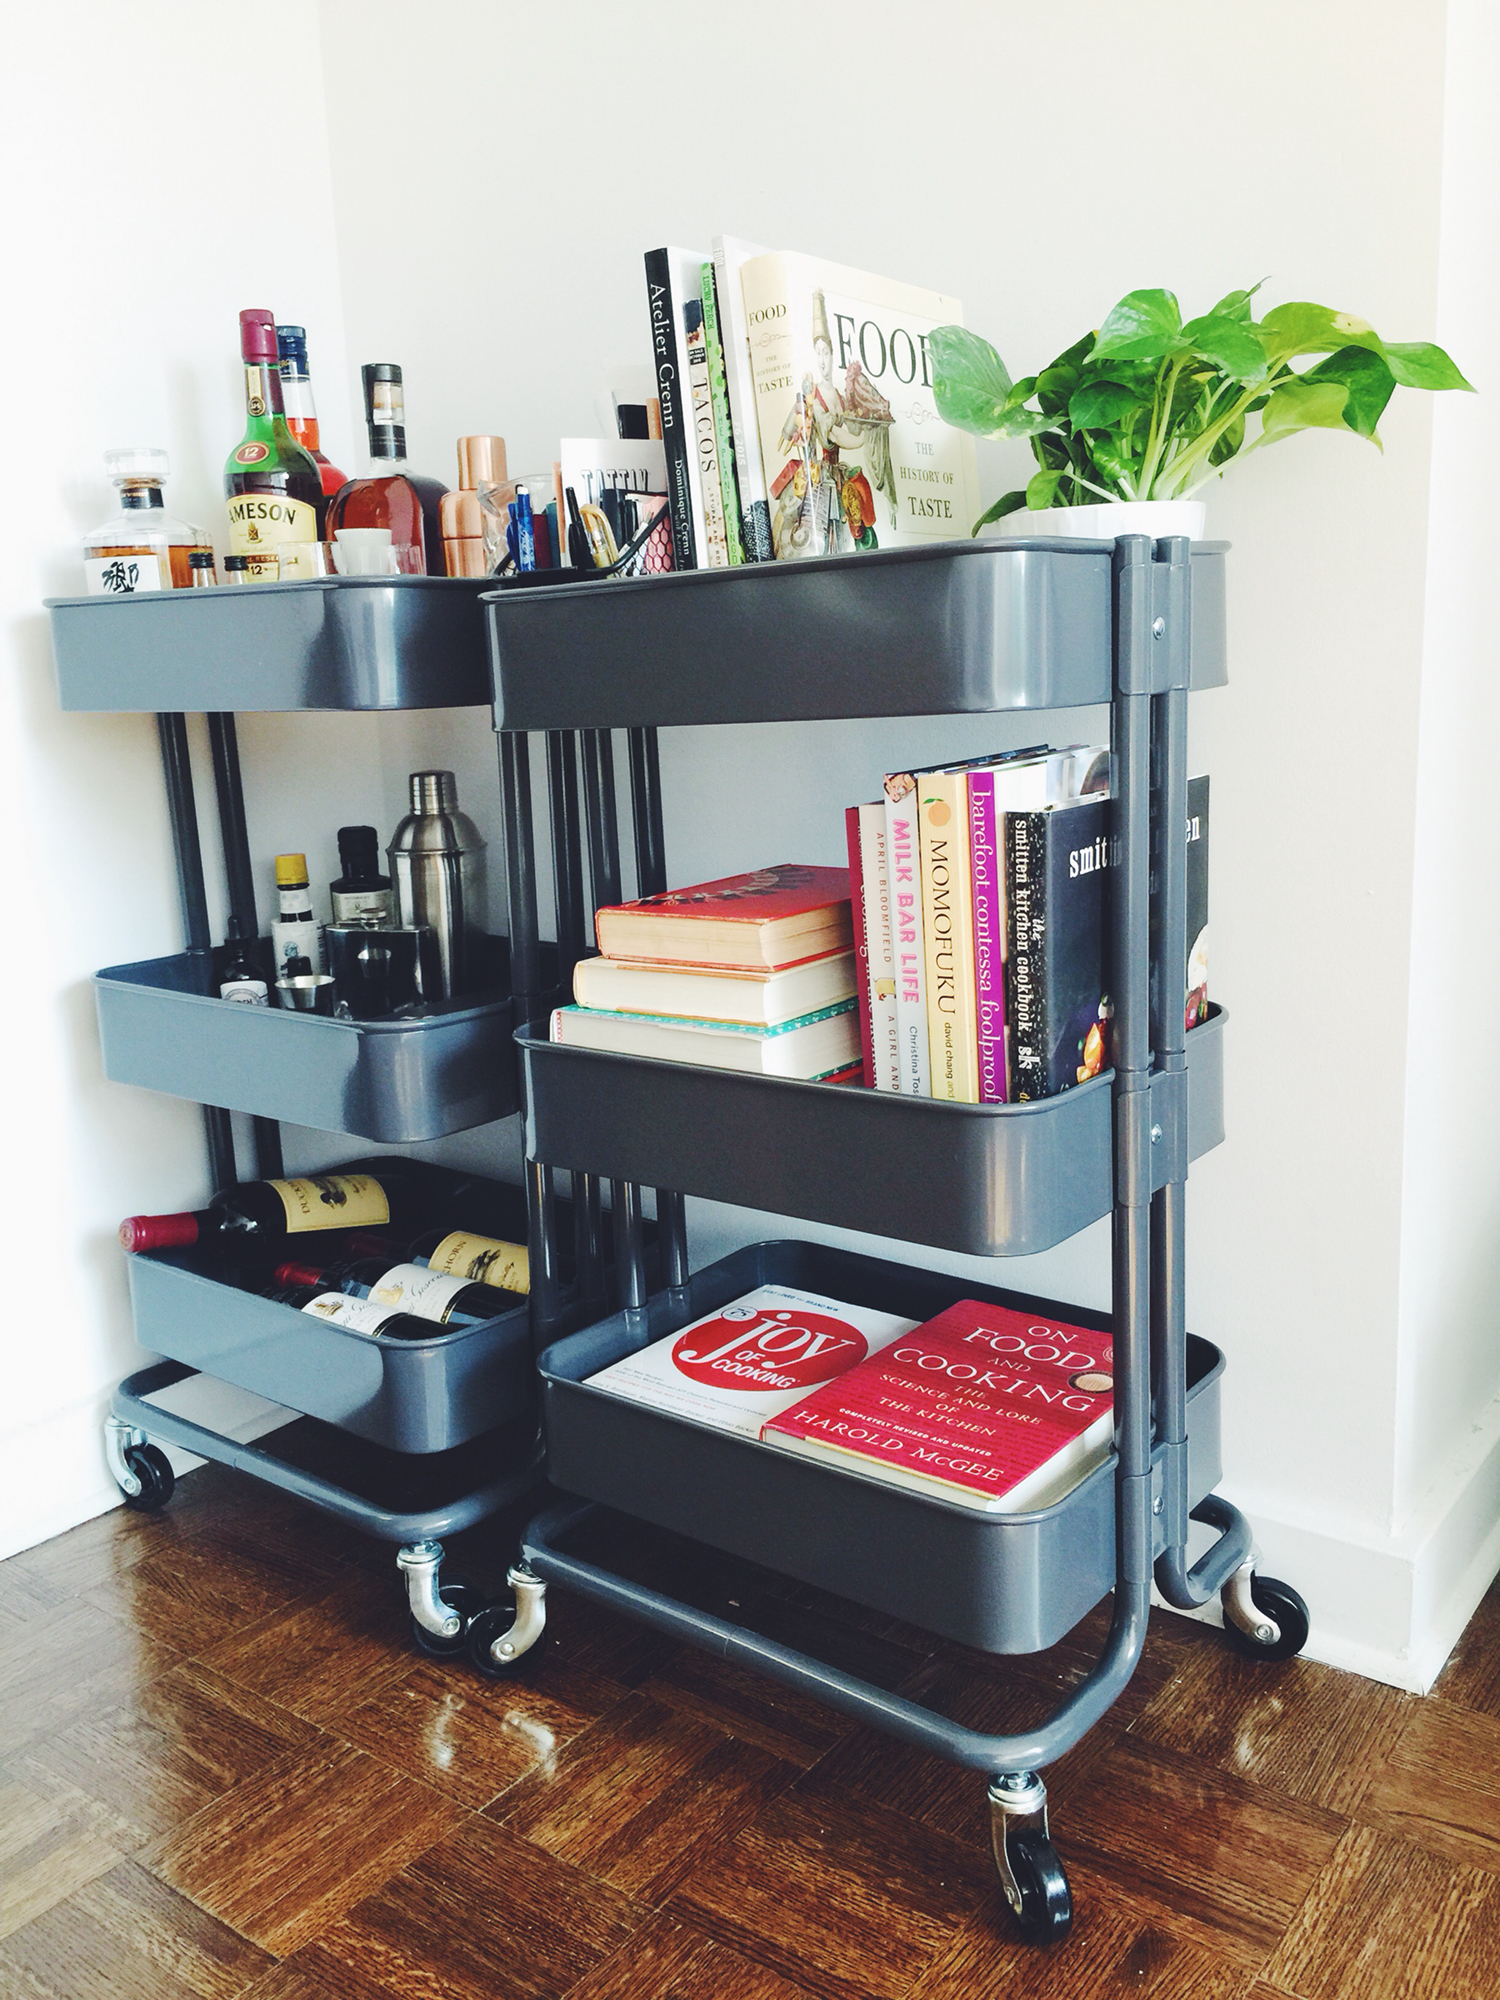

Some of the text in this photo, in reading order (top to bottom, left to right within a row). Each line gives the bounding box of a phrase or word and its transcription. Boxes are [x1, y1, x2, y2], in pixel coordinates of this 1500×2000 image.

[749, 303, 787, 326] FOOD
[650, 283, 675, 428] Atelier Crenn
[756, 364, 781, 377] HISTORY
[757, 375, 793, 394] TASTE
[692, 377, 717, 473] TACOS
[244, 446, 259, 459] 12
[736, 440, 746, 466] 2015
[914, 441, 934, 456] THE
[721, 449, 731, 499] PLANT
[899, 466, 955, 485] HISTORY OF
[674, 459, 690, 555] Dominique Crenn
[908, 496, 953, 519] TASTE
[250, 565, 263, 576] 12
[876, 832, 892, 963] APRIL BLOOMFIELD
[892, 818, 920, 1004] MILK BAR LIFE
[930, 840, 956, 1015] MOMOFUKU
[1015, 820, 1033, 1031] smitten kitchen cookbook
[972, 790, 1004, 1104] barefoot contessa foolproof
[888, 1029, 898, 1058] GIRL
[909, 1026, 919, 1074] Christina
[1018, 1046, 1041, 1070] sk
[944, 1022, 955, 1098] david chang and
[891, 1066, 900, 1091] AND
[962, 1326, 1096, 1370] FOOD
[1027, 1325, 1079, 1344] ON
[735, 1350, 765, 1362] OF
[987, 1356, 1031, 1372] AND
[711, 1359, 797, 1388] COOKING
[892, 1347, 1097, 1412] COOKING
[879, 1374, 1044, 1426] SCIENCE AND LORE
[955, 1385, 988, 1399] THE
[879, 1396, 997, 1437] THE KITCHEN
[935, 1402, 961, 1414] OF
[793, 1410, 1005, 1482] HAROLD McGEE
[838, 1407, 993, 1458] COMPLETELY REVISED AND UPDATED
